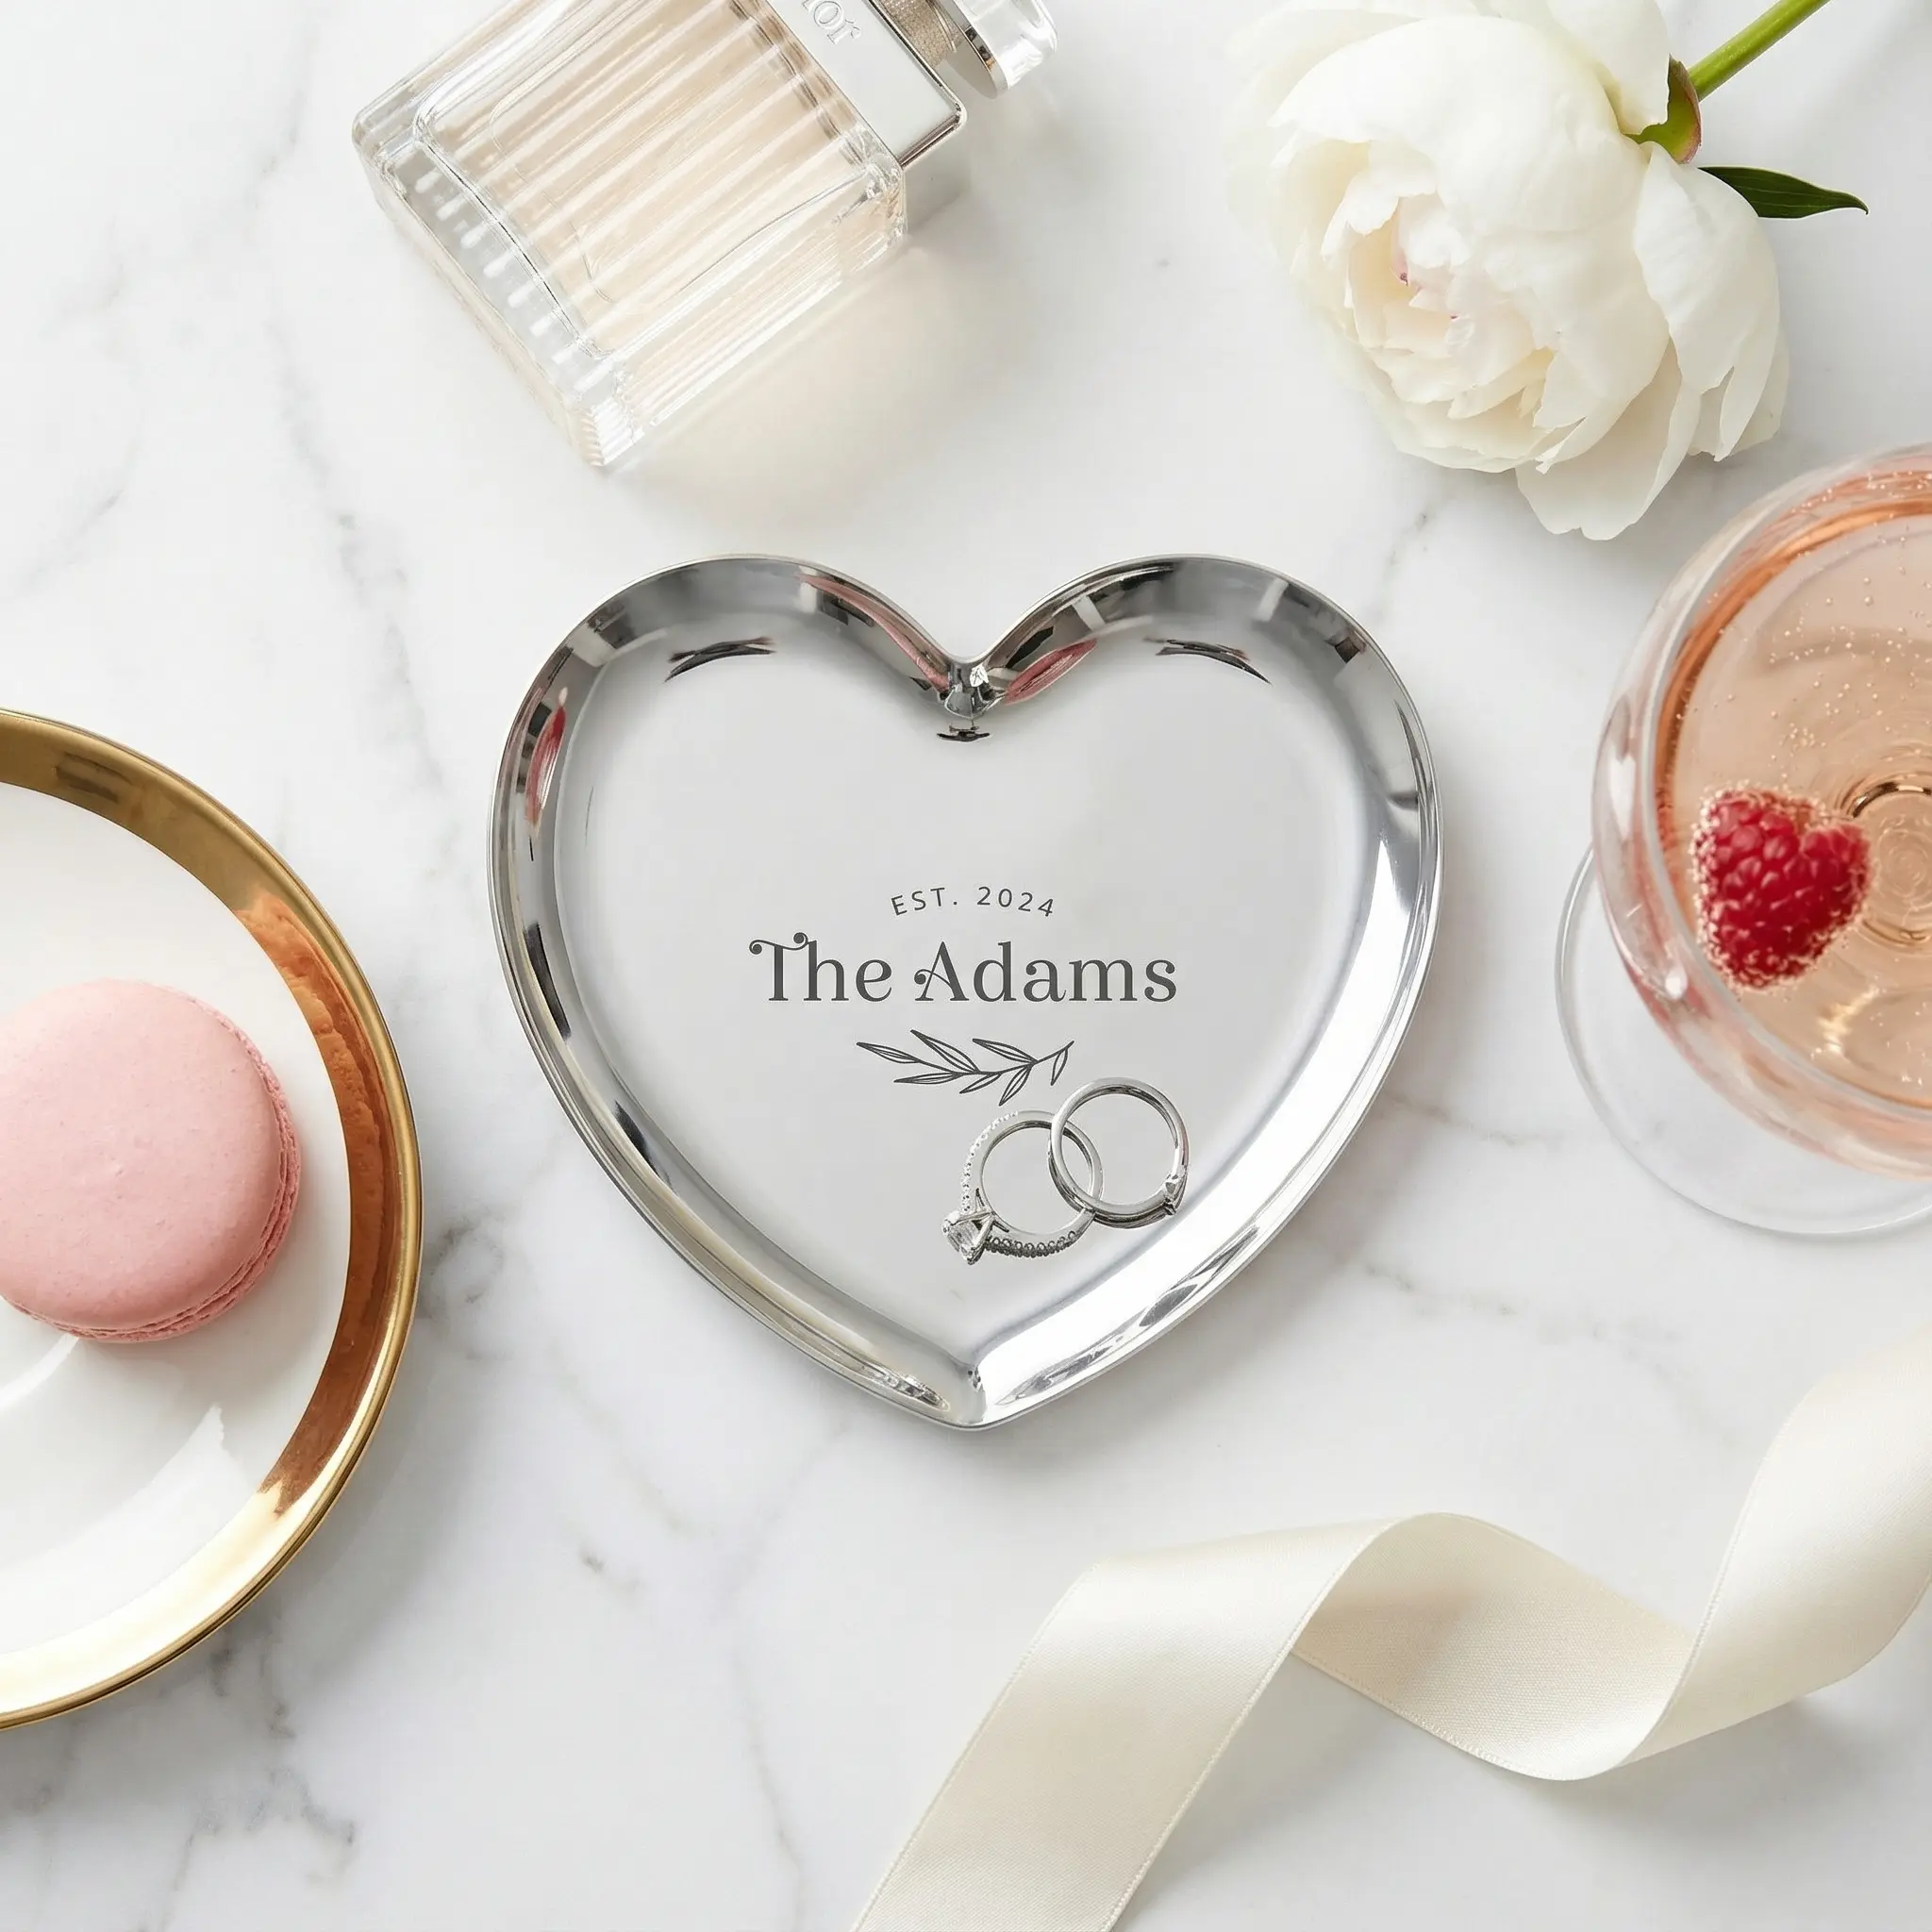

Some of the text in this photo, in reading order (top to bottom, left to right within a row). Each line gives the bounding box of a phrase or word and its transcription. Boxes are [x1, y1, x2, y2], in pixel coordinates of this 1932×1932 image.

[891, 886, 1055, 918] EST. 2024
[748, 932, 1177, 1003] The Adams
